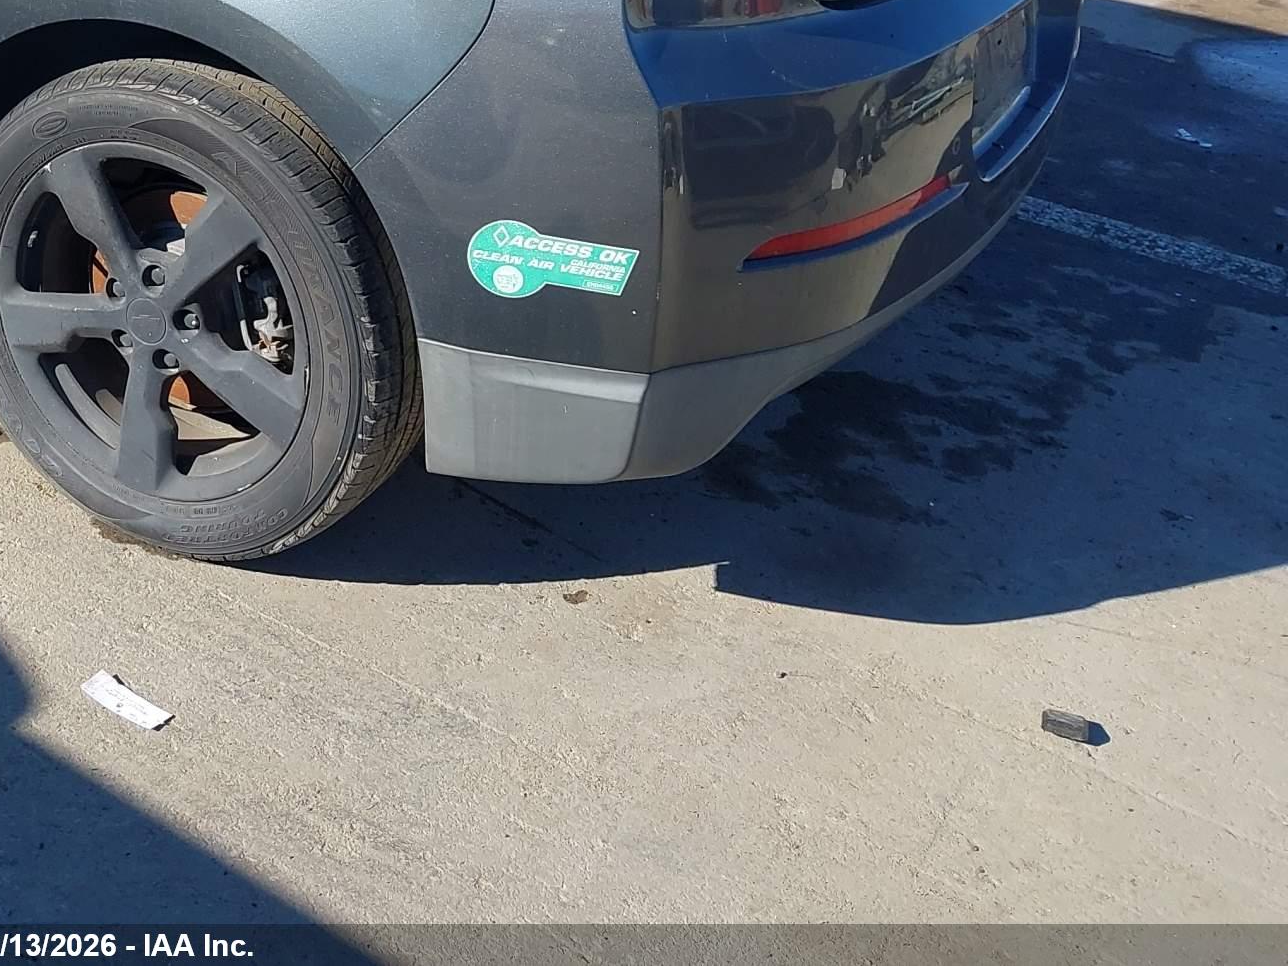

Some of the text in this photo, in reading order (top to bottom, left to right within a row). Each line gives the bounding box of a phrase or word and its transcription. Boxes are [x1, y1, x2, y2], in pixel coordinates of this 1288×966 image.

[508, 235, 633, 264] ACCESS OK
[472, 249, 625, 282] CLEAN AIR VEHICLE
[569, 258, 627, 274] CALIFORNIA
